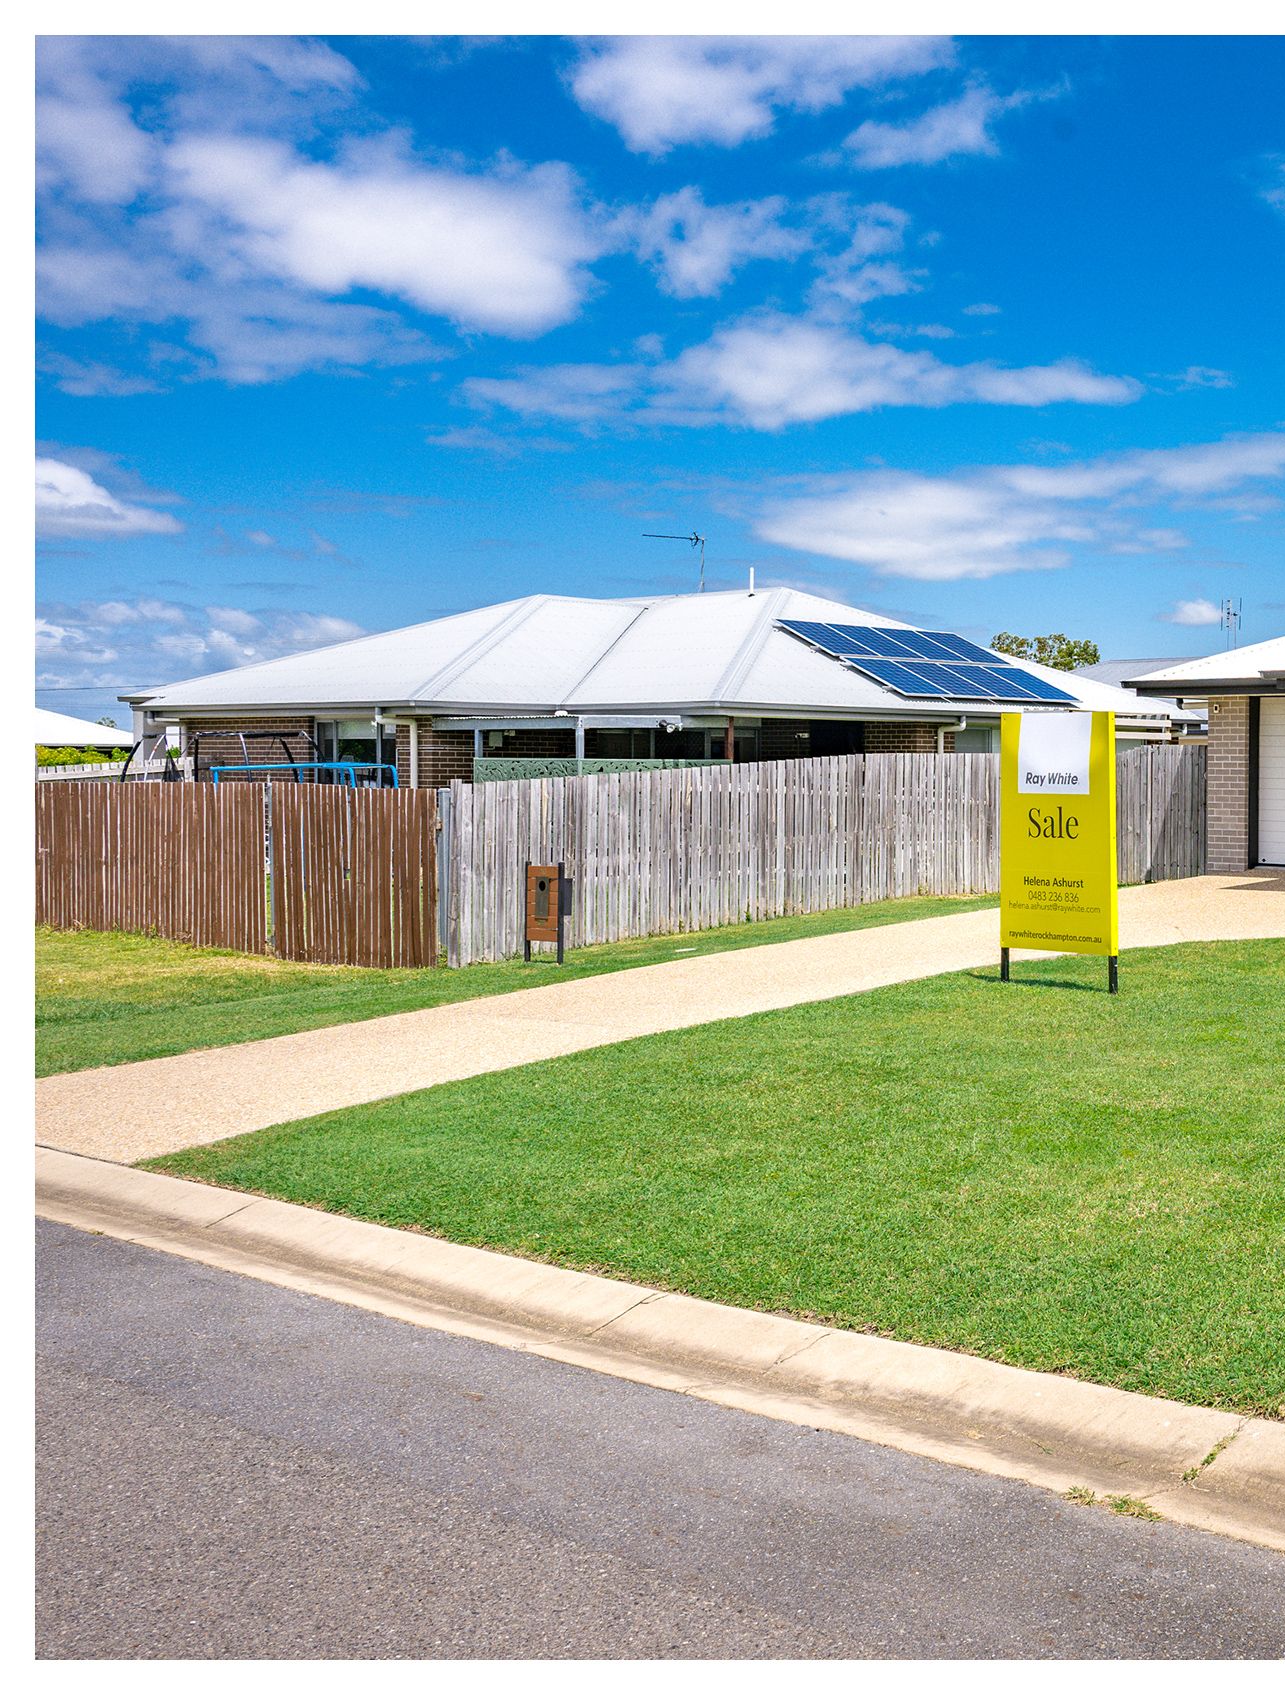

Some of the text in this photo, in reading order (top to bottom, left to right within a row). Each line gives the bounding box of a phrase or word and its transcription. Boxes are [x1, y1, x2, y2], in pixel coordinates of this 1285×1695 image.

[1025, 772, 1079, 787] Ray White
[1028, 806, 1079, 840] Sale
[1023, 876, 1084, 888] Helena Ashurst
[1027, 890, 1080, 903] 0483 236 836
[1008, 900, 1101, 914] helena.ashurst@raywhite.com
[1008, 930, 1102, 943] raywhiterockhampton.com.au
